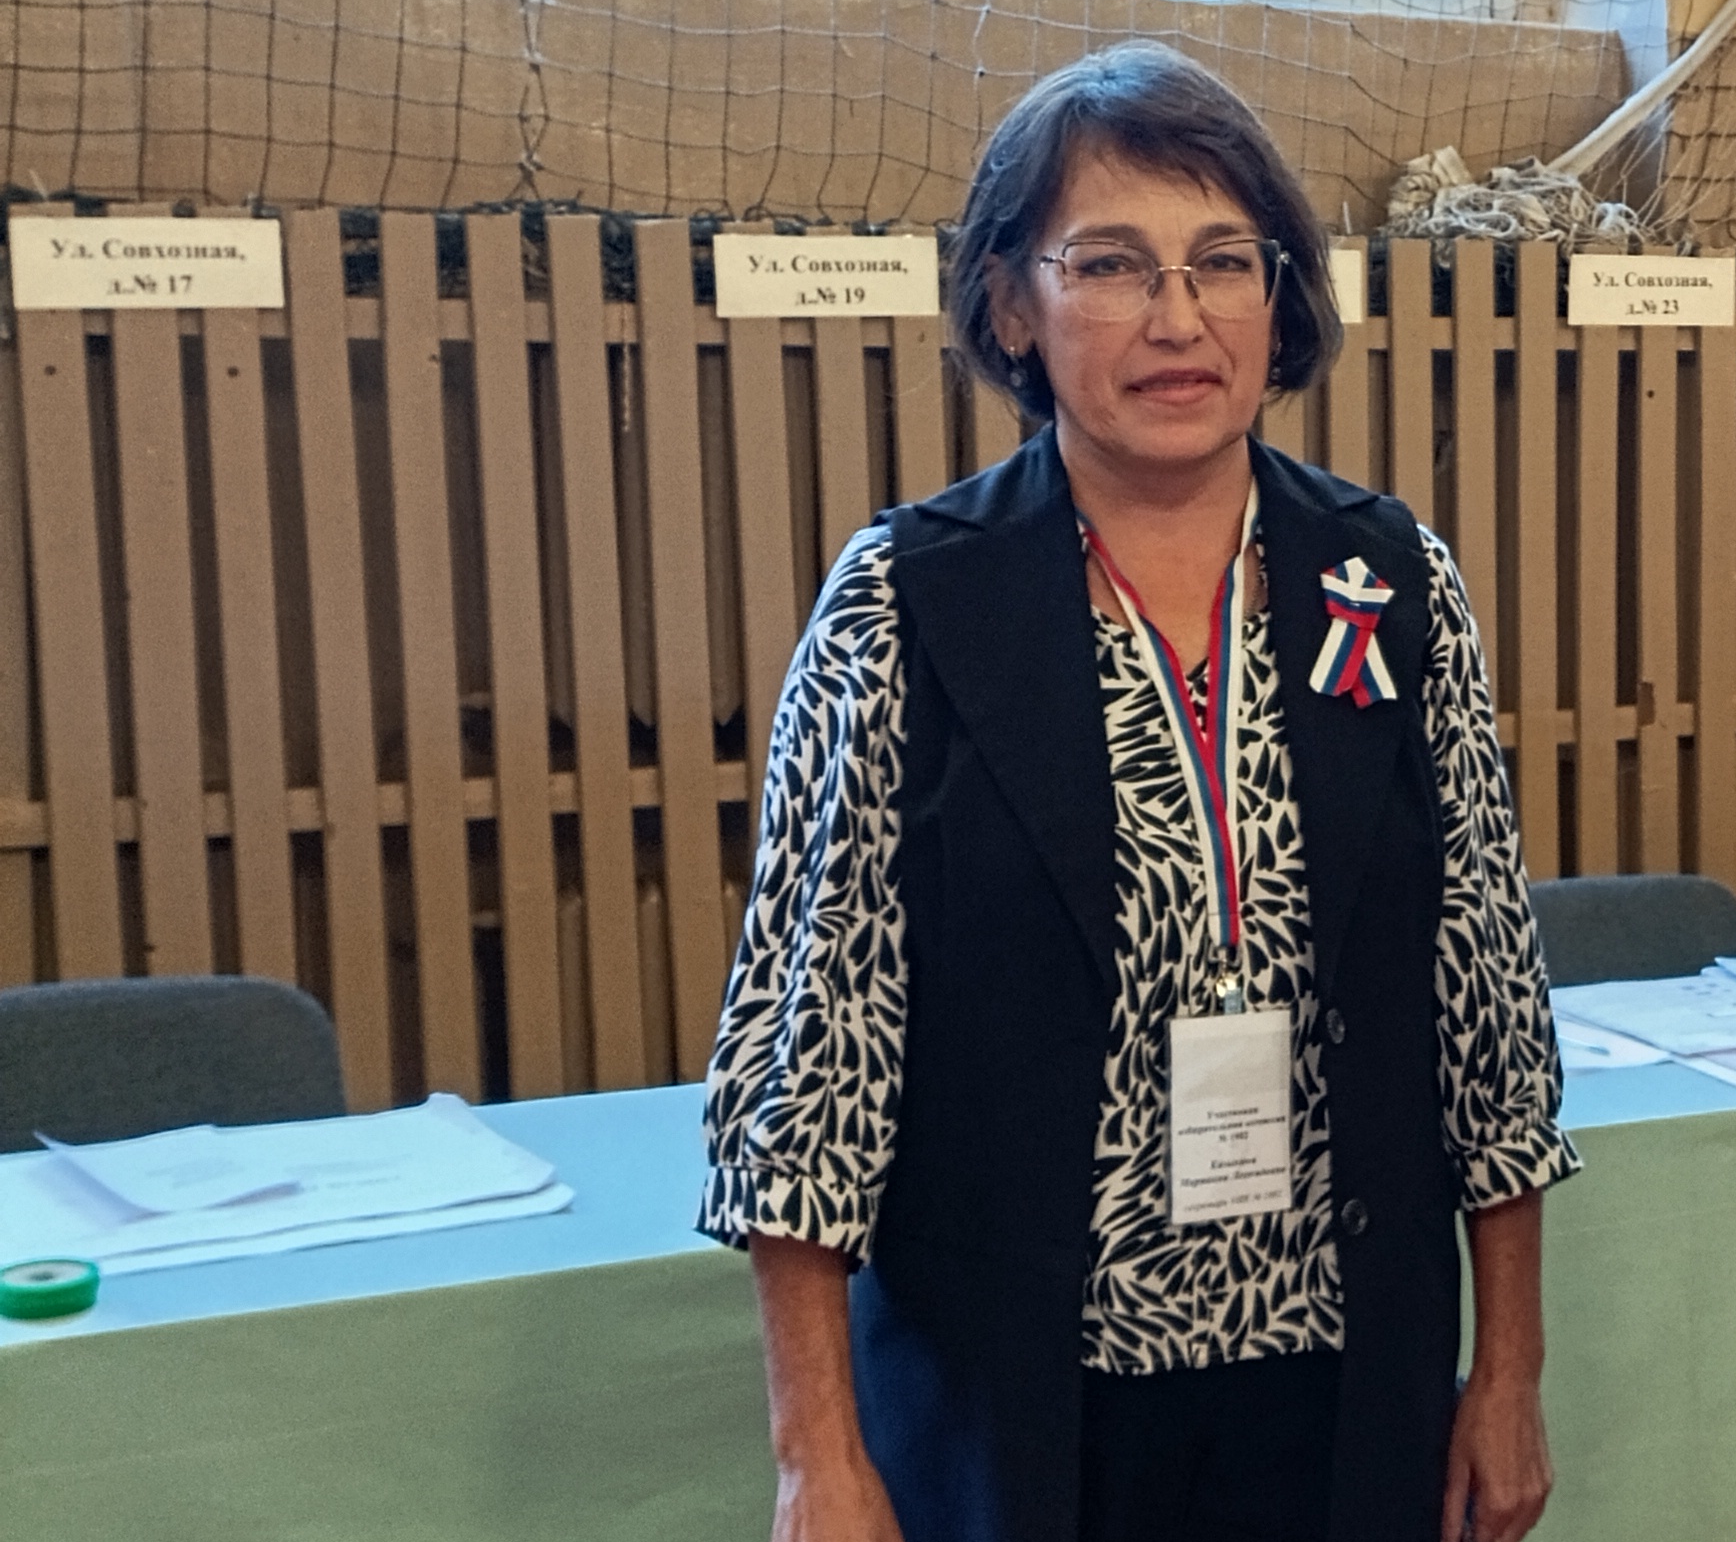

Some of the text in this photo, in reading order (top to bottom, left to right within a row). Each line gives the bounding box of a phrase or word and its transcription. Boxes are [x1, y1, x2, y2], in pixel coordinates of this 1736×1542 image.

[51, 238, 246, 261] Ул. Совхозная,
[748, 254, 908, 275] Ул. Совхозная,
[168, 275, 193, 294] 17
[1593, 271, 1713, 289] Ул. Совхозная,
[845, 287, 865, 304] 19
[1663, 299, 1680, 315] 23
